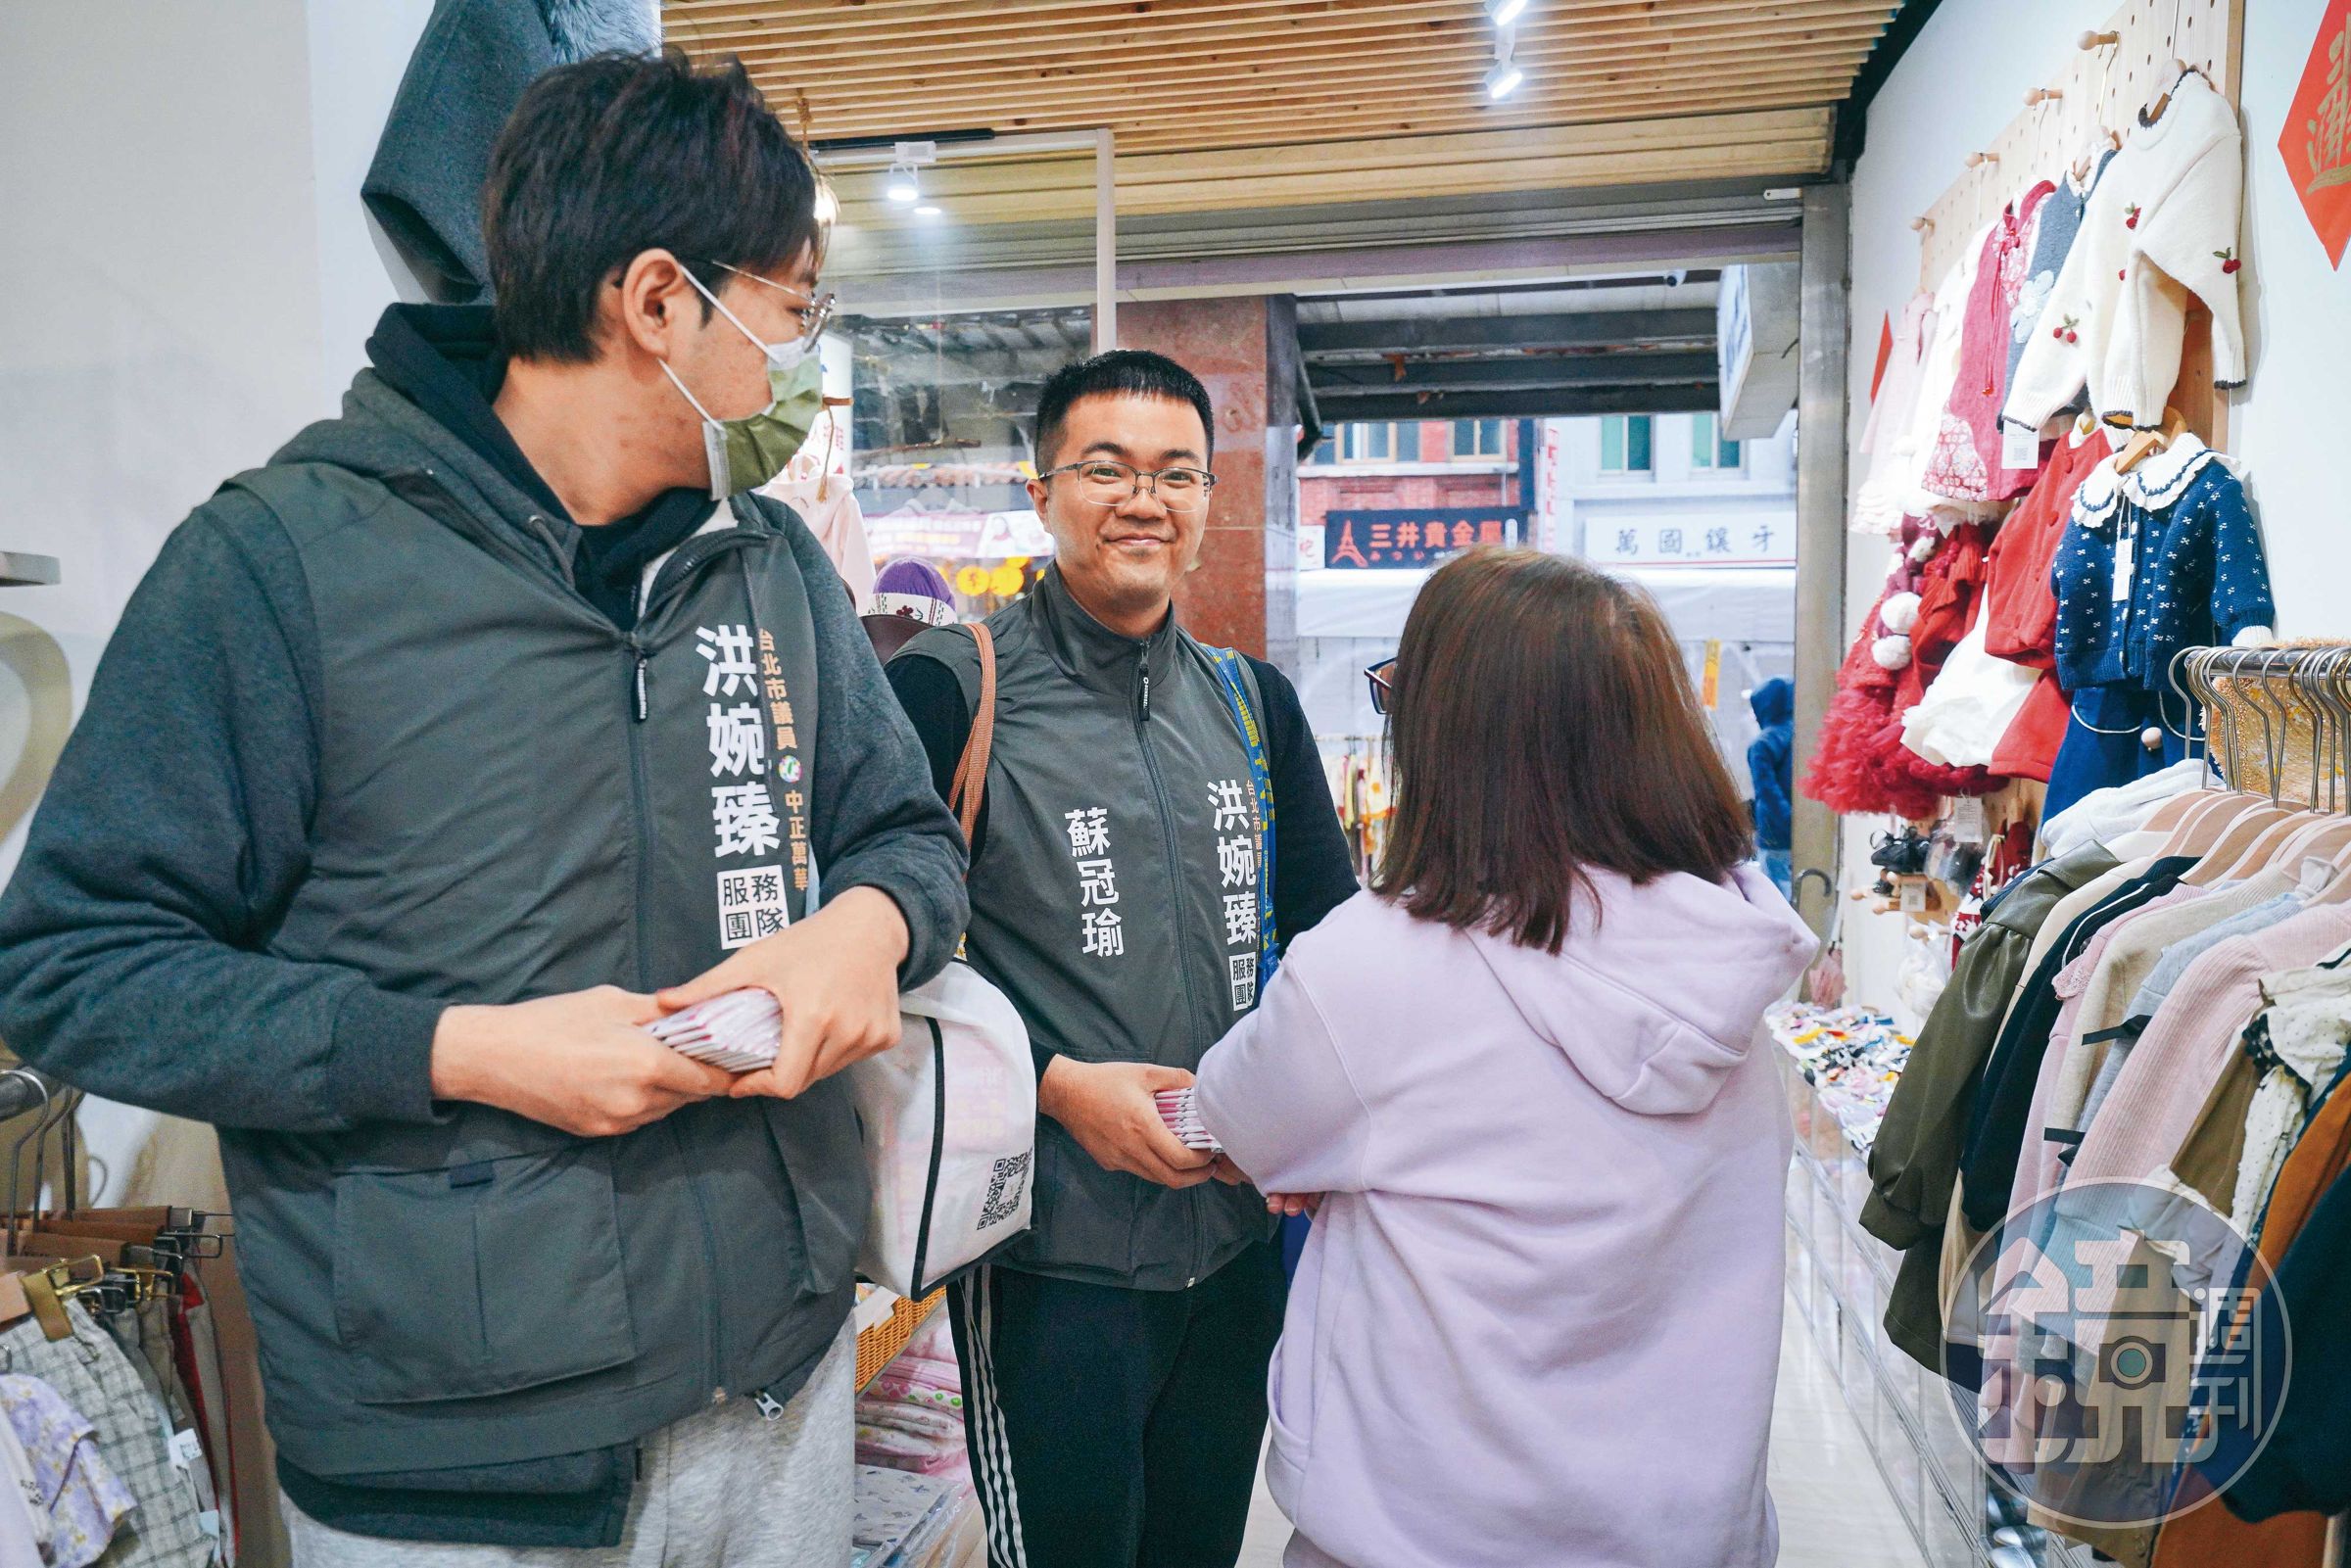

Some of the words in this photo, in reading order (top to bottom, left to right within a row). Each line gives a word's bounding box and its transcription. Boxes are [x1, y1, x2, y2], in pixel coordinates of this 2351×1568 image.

[696, 624, 780, 858] 洪婉臻
[758, 628, 797, 751] 台北市議員
[723, 874, 779, 906] 服務
[726, 907, 785, 941] 團隊
[1065, 806, 1125, 959] 蘇冠瑜
[1207, 779, 1258, 946] 洪婉臻
